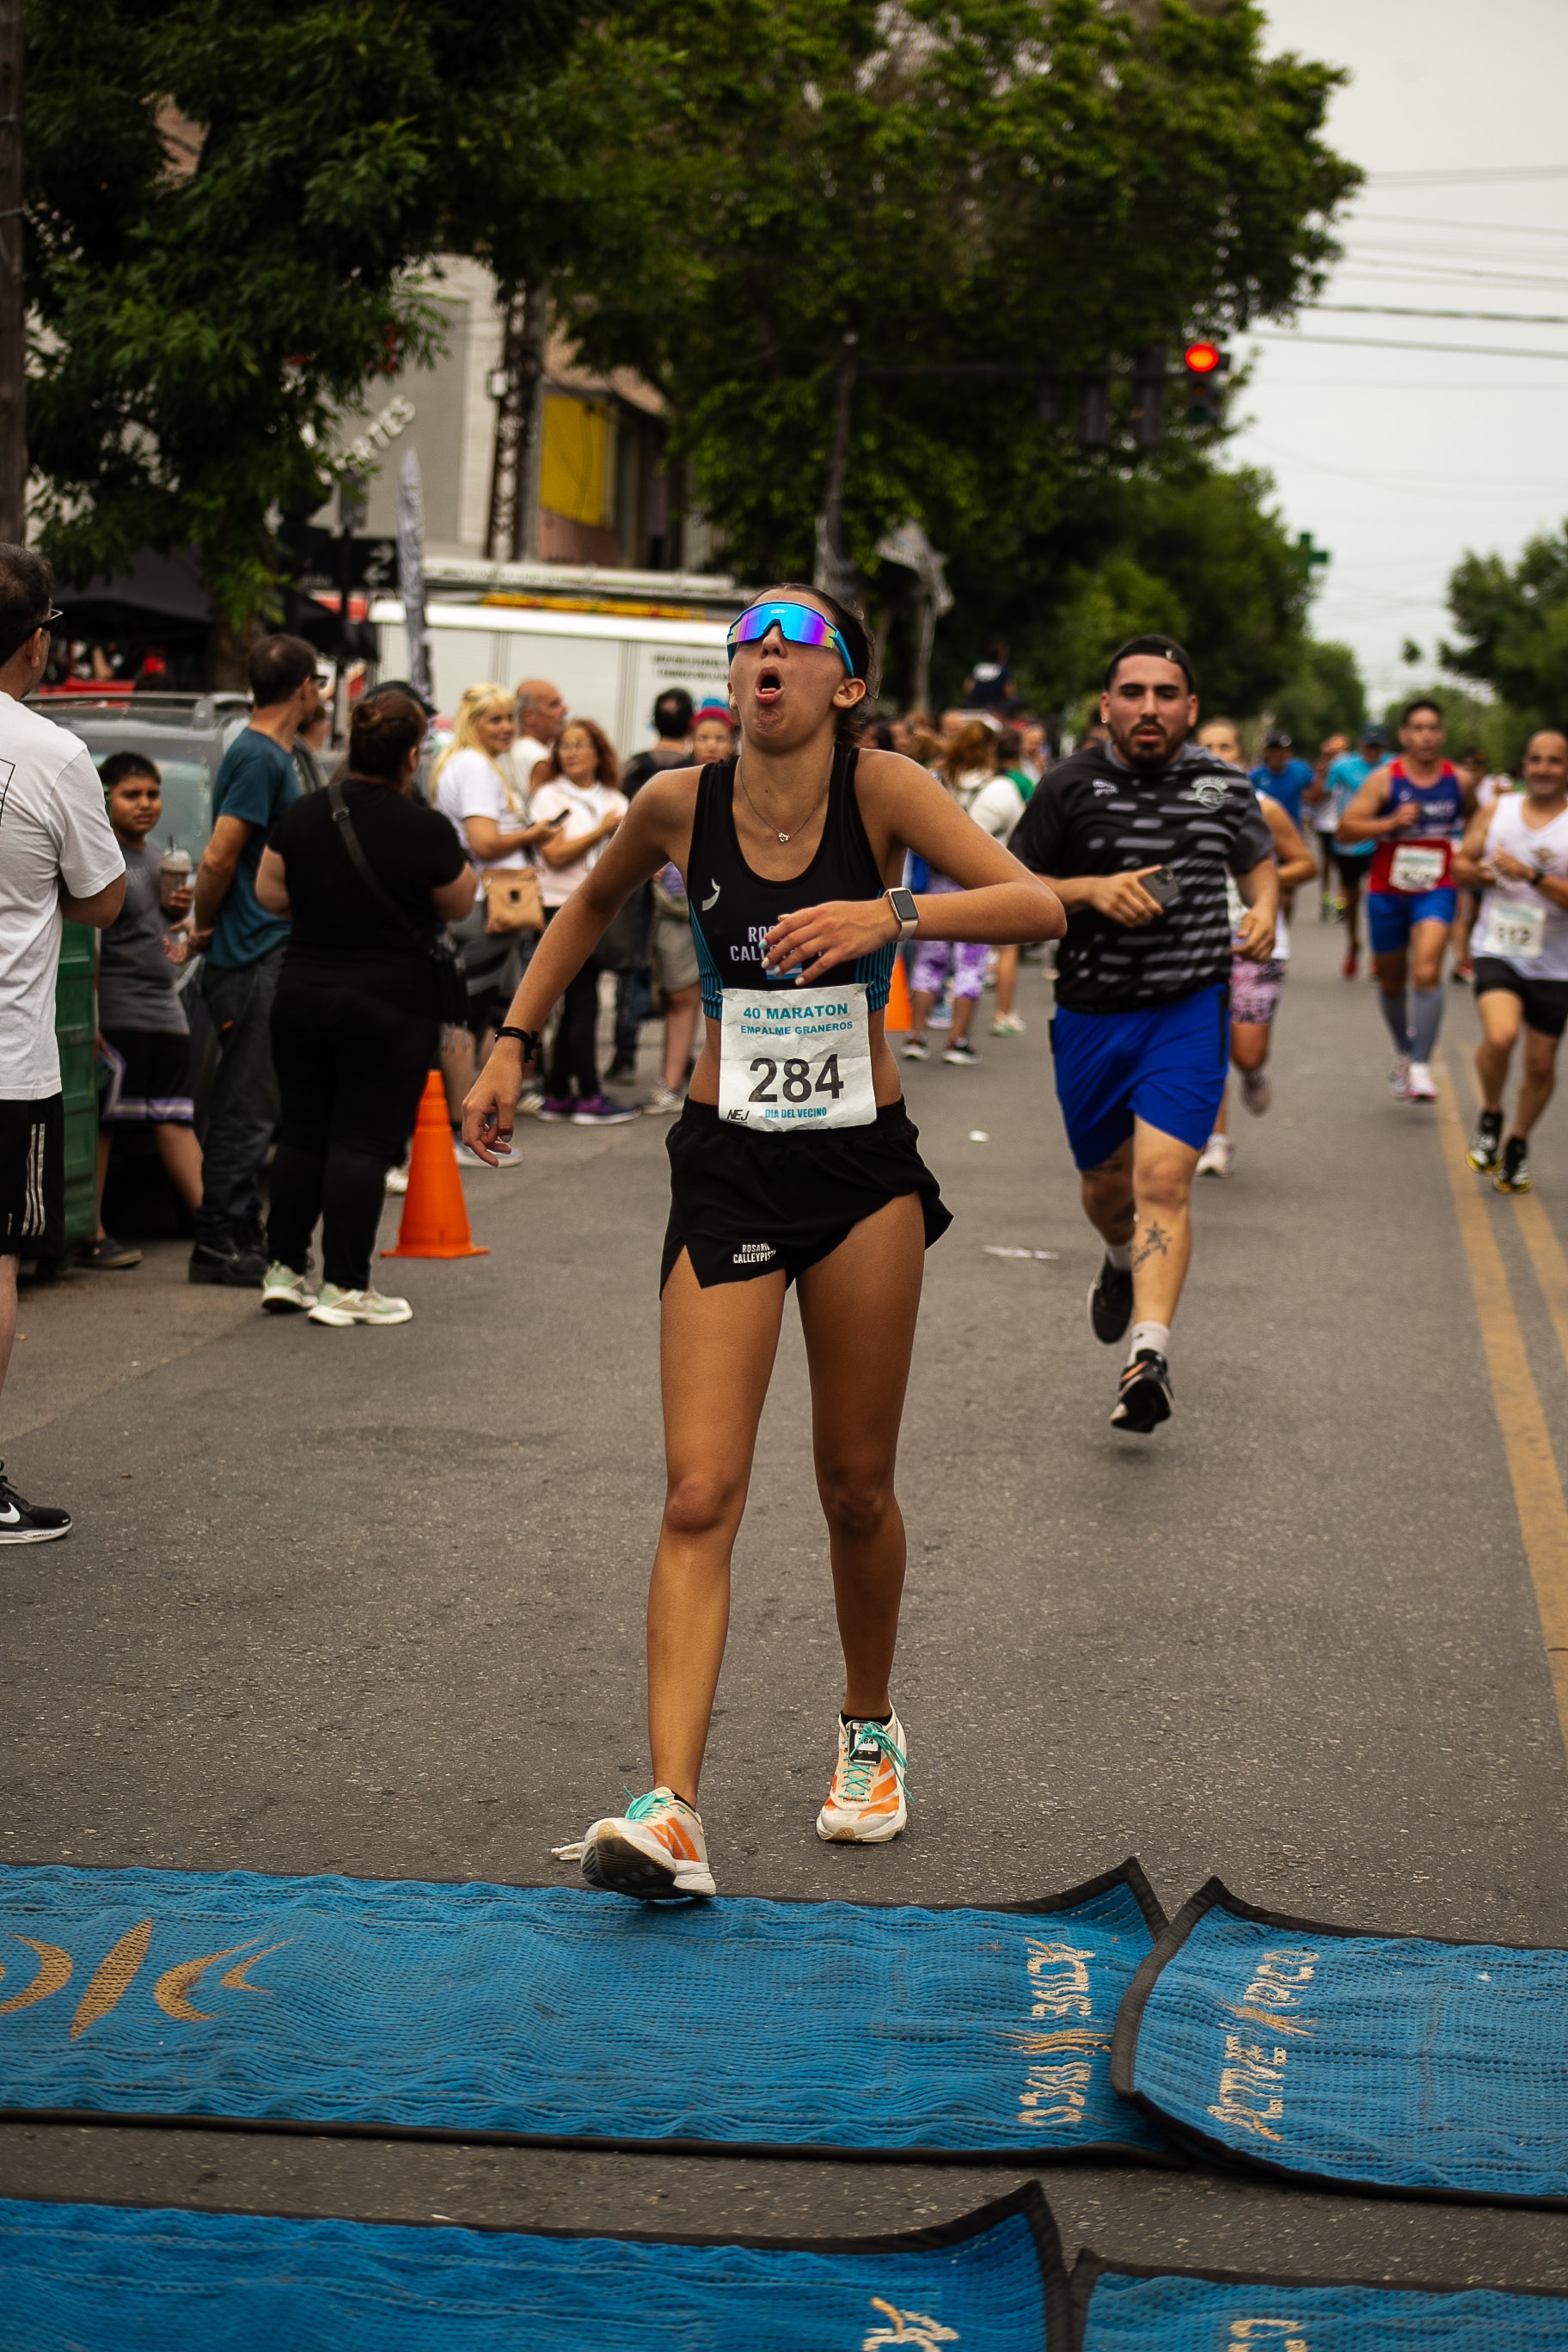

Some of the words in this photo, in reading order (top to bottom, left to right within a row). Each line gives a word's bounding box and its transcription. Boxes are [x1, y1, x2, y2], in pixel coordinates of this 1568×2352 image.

[743, 1007, 761, 1020] 40
[766, 1002, 848, 1020] MARATON
[740, 1025, 791, 1036] EMPALME
[794, 1020, 853, 1035] GRANEROS
[748, 1053, 844, 1103] 284
[726, 1109, 750, 1121] NEJ
[764, 1109, 779, 1118] DIA
[781, 1108, 795, 1118] DEL
[797, 1106, 827, 1118] VECINO
